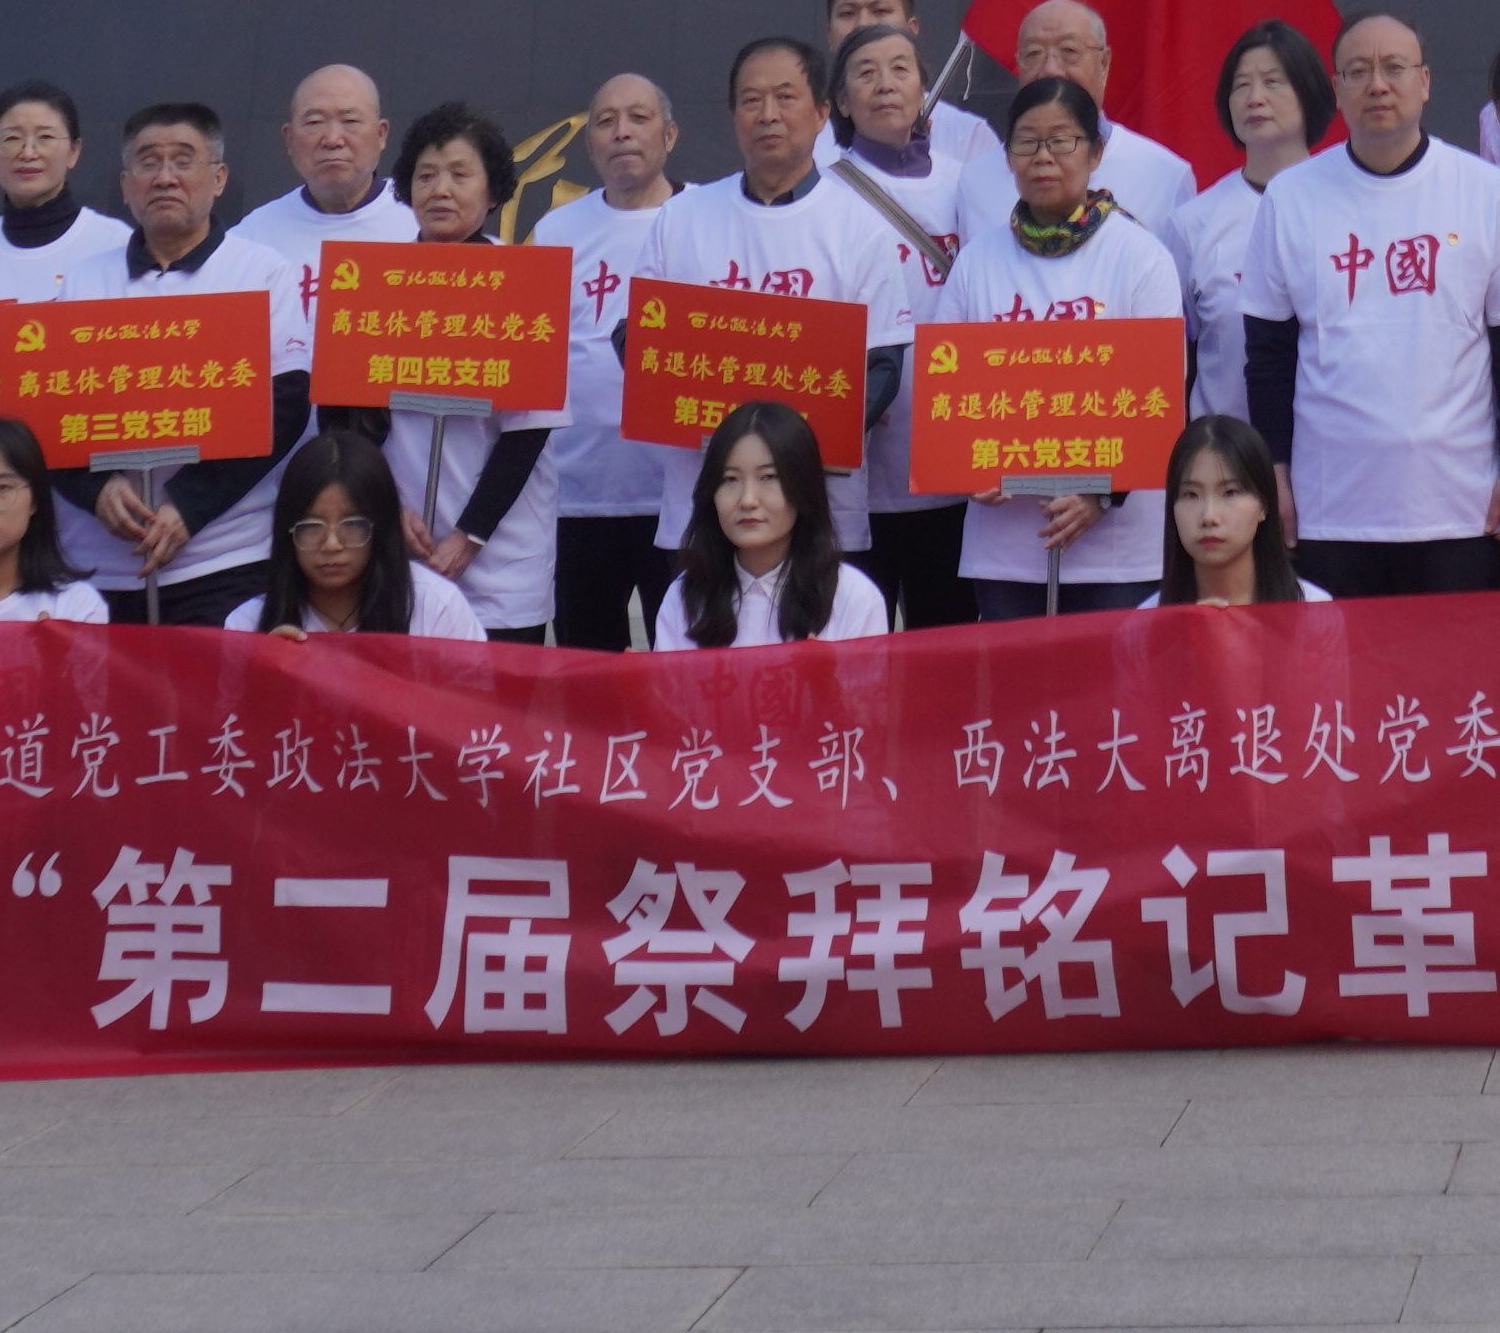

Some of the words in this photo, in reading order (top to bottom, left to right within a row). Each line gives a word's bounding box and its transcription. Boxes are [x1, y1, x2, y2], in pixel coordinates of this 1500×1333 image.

[383, 270, 506, 292] 西北政法大学
[71, 319, 201, 345] 西北政法大学
[331, 309, 556, 344] 离退休管理处党委
[688, 311, 804, 342] 西北政法大学
[368, 355, 511, 388] 第四党支部
[640, 346, 853, 400] 离退休管理处党委
[984, 344, 1115, 367] 西北政法大学
[17, 358, 258, 398] 离退休管理处党委
[930, 386, 1171, 422] 离退休管理处党委
[59, 406, 213, 444] 第三党支部
[971, 436, 1124, 471] 第六党支部
